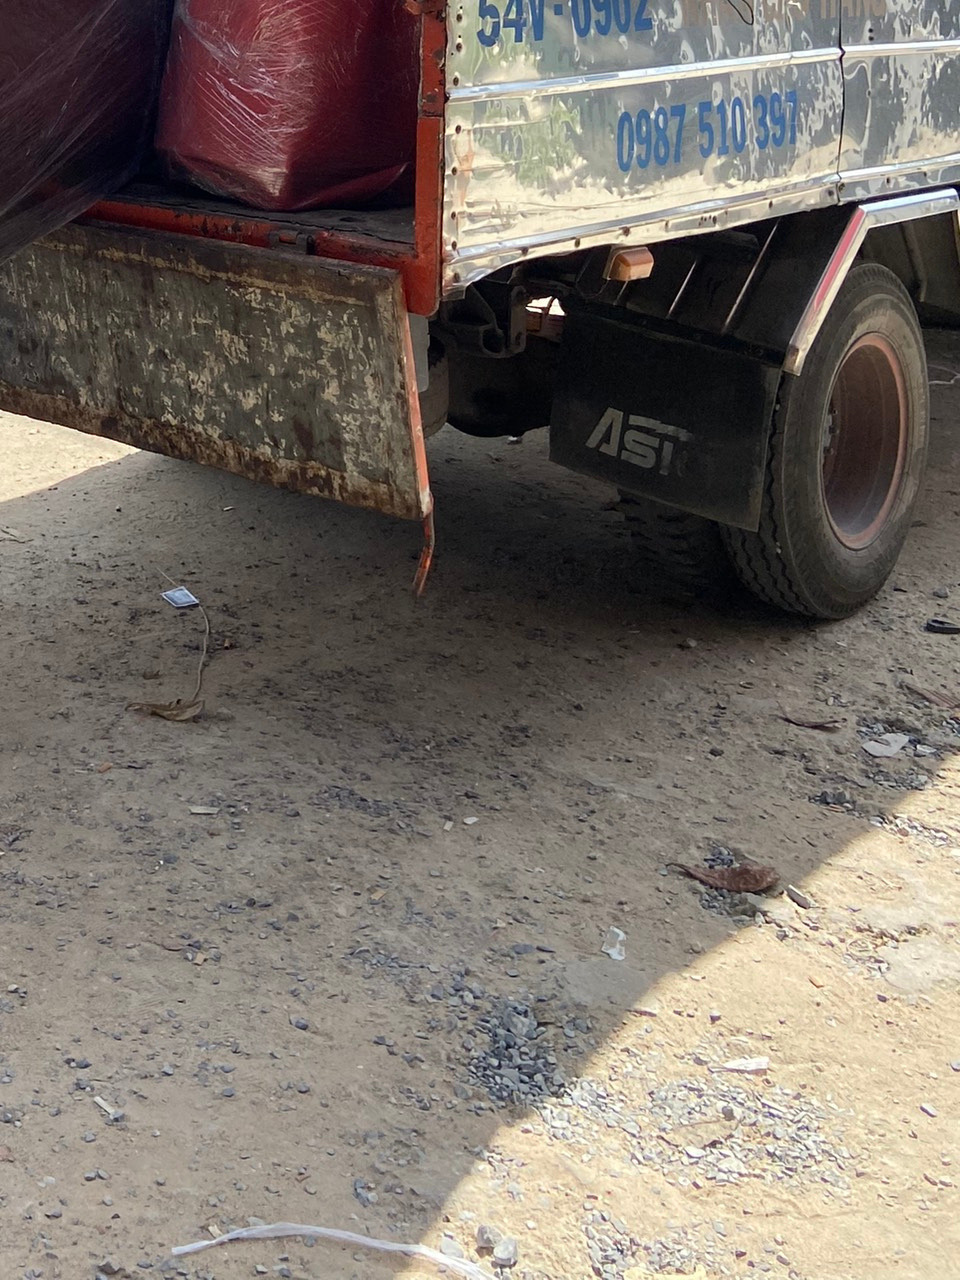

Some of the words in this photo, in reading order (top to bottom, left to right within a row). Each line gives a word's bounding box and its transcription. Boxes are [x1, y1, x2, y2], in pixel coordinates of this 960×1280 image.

[617, 103, 686, 172] 0987
[698, 96, 746, 158] 510
[753, 90, 797, 150] 397
